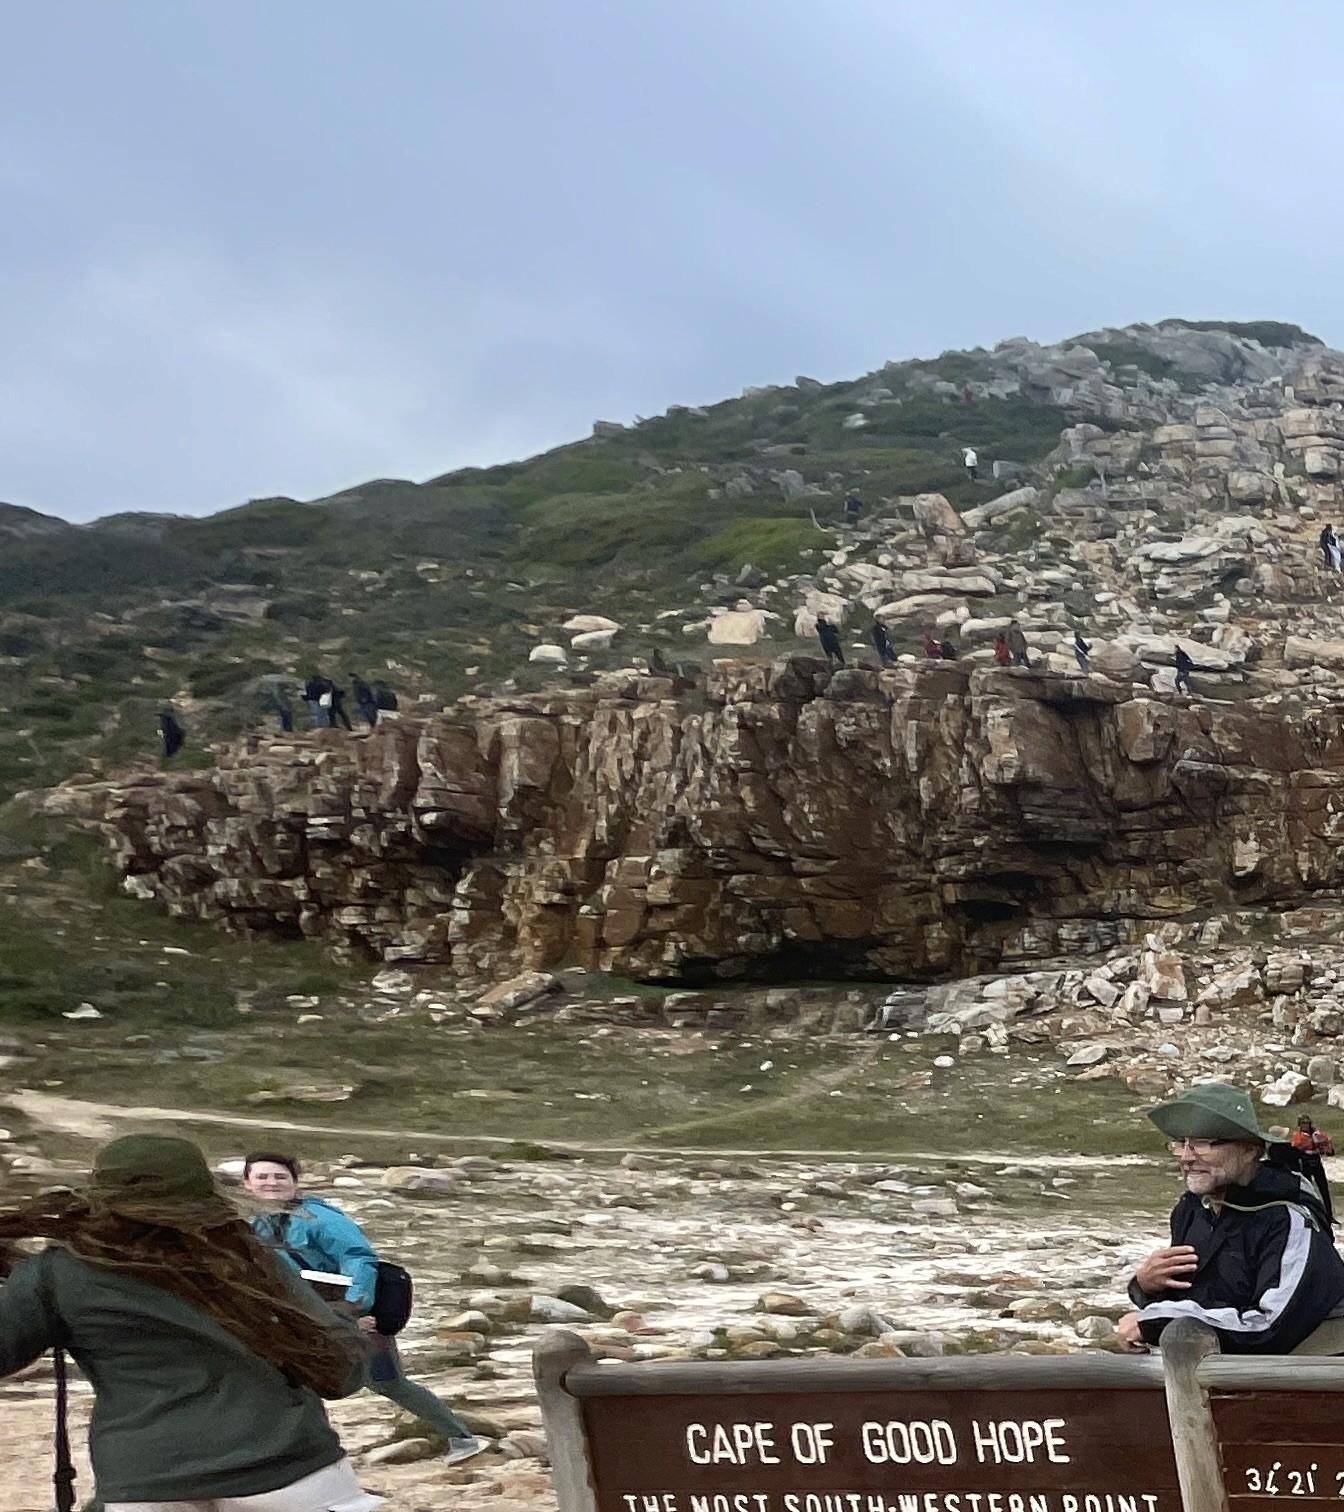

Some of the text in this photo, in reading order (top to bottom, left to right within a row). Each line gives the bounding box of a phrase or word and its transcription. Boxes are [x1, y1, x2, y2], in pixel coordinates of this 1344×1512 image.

[686, 1418, 1071, 1465] CAPE OF GOOD HOPE
